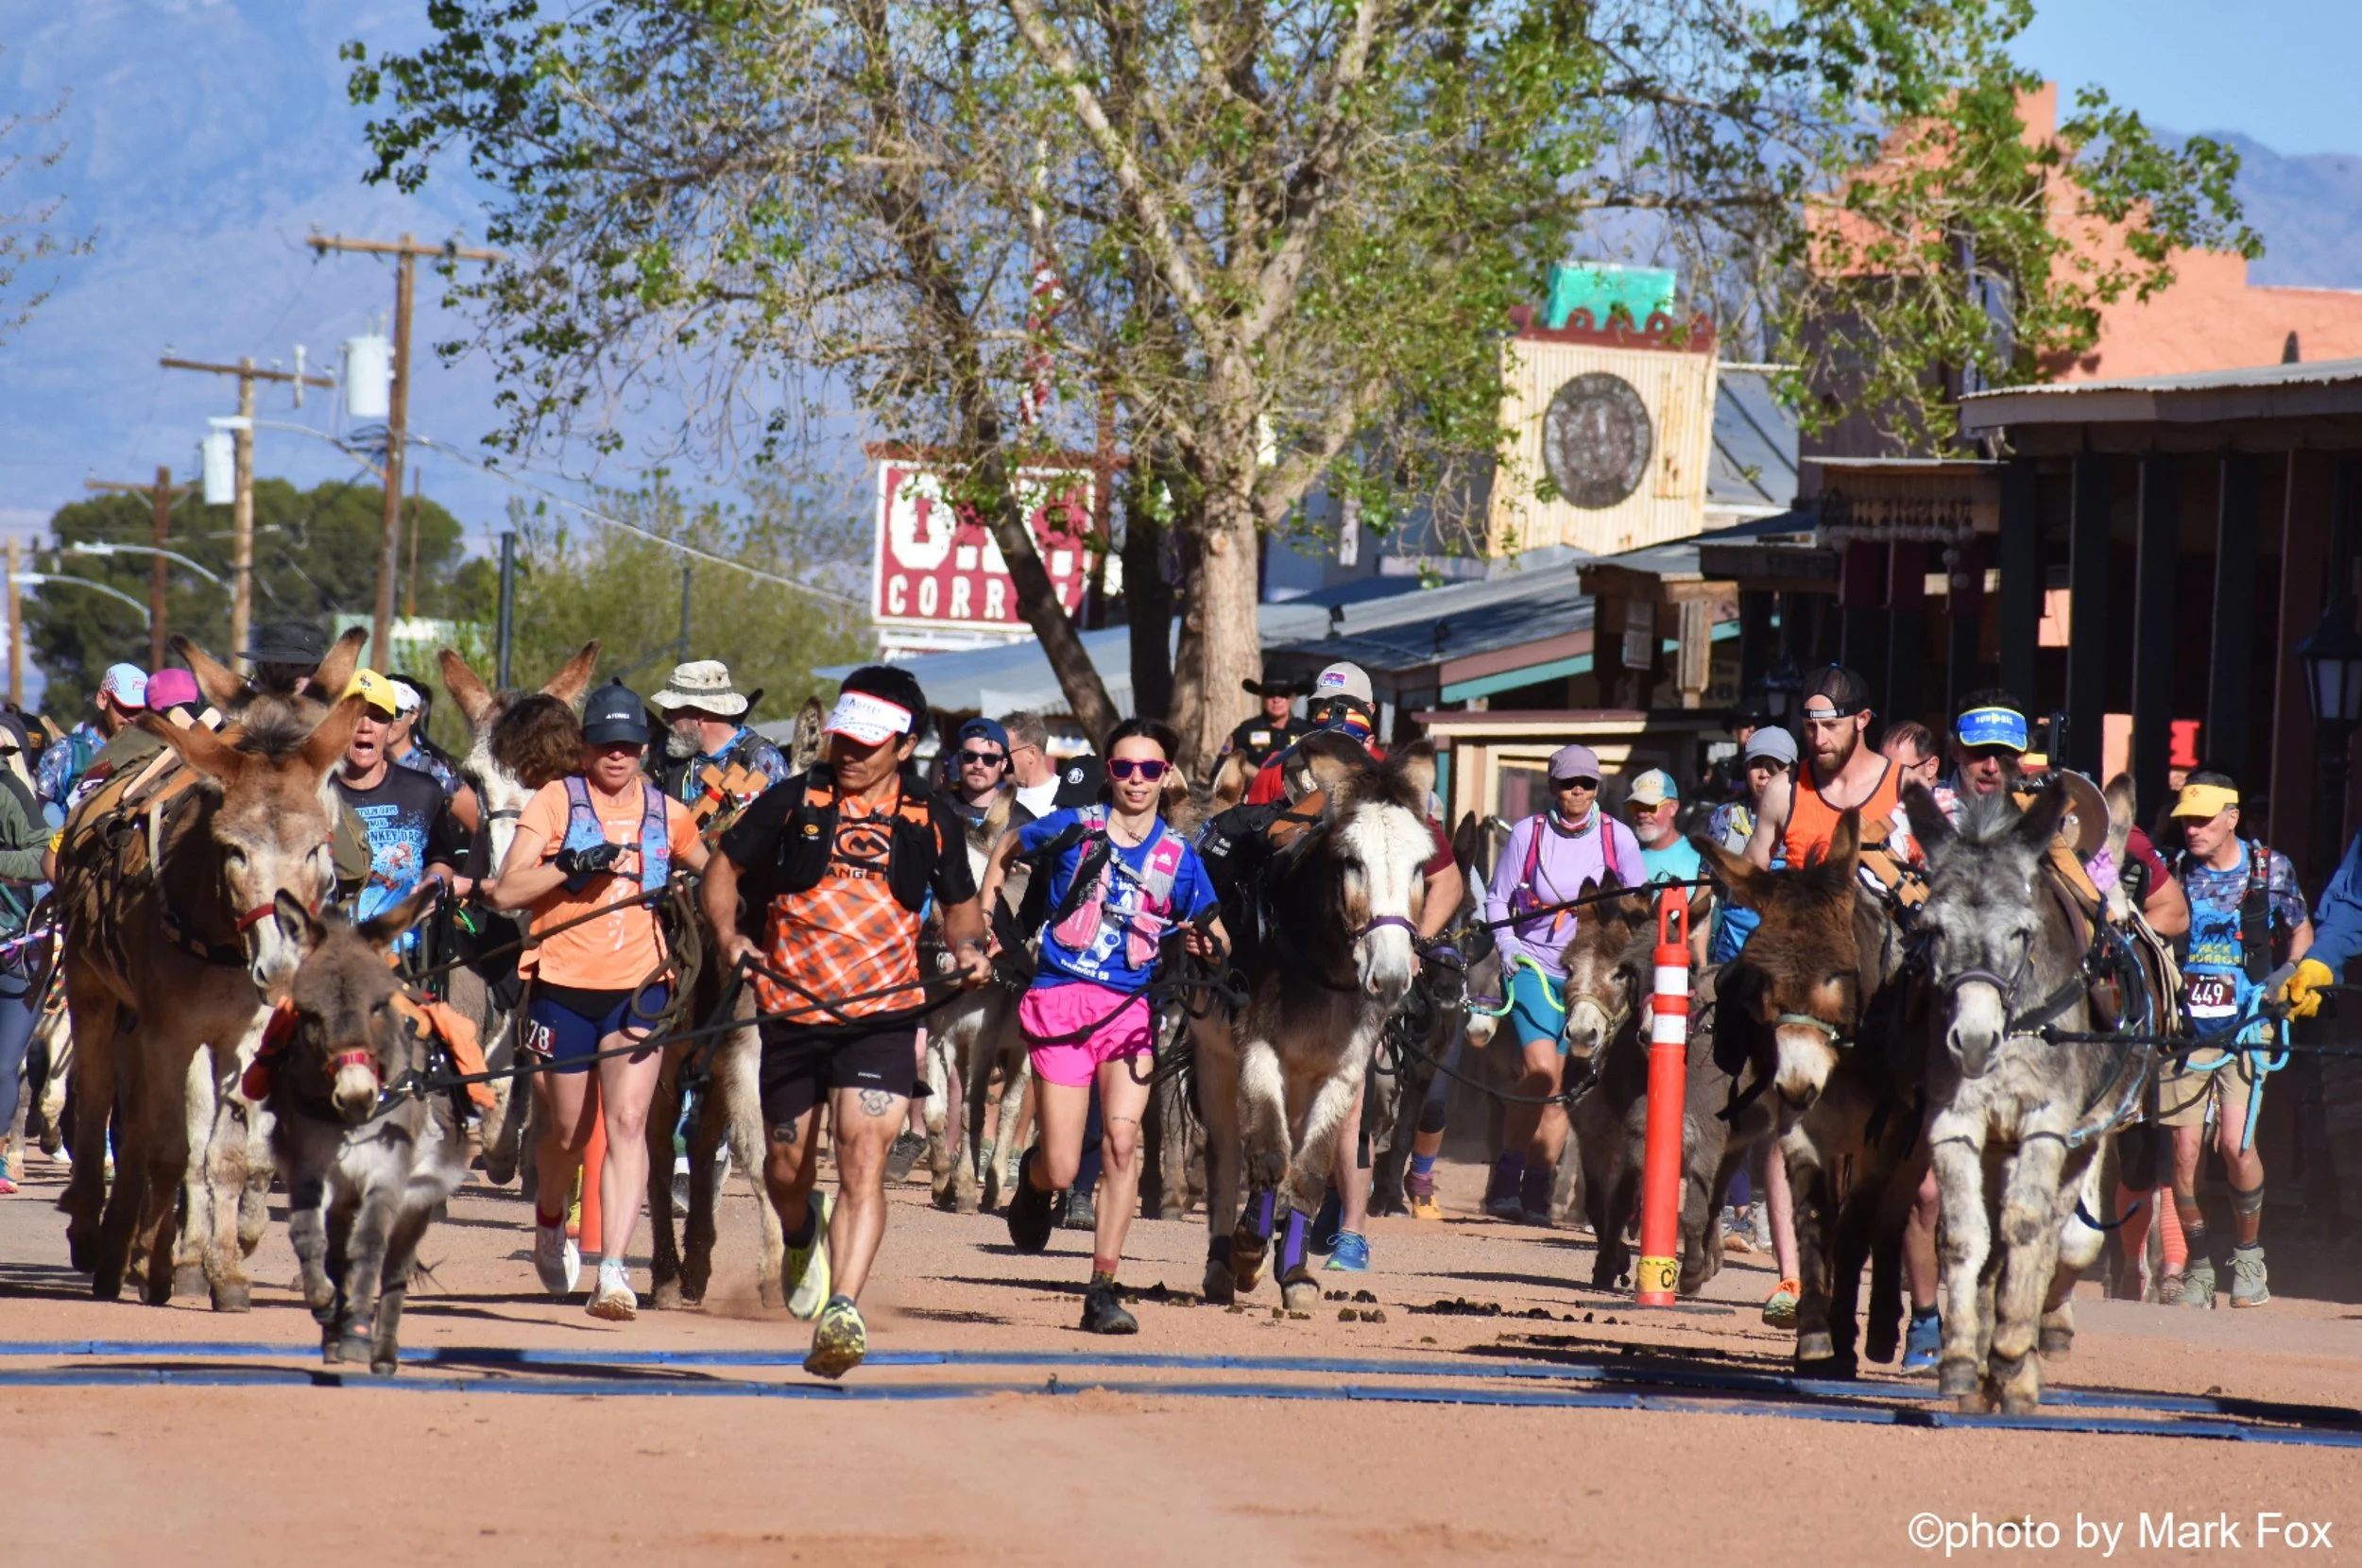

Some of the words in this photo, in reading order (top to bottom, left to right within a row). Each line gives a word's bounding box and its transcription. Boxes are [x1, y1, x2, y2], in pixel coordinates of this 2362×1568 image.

[888, 573, 1074, 621] CORR
[827, 866, 876, 881] ANGE
[2191, 982, 2224, 1005] 449
